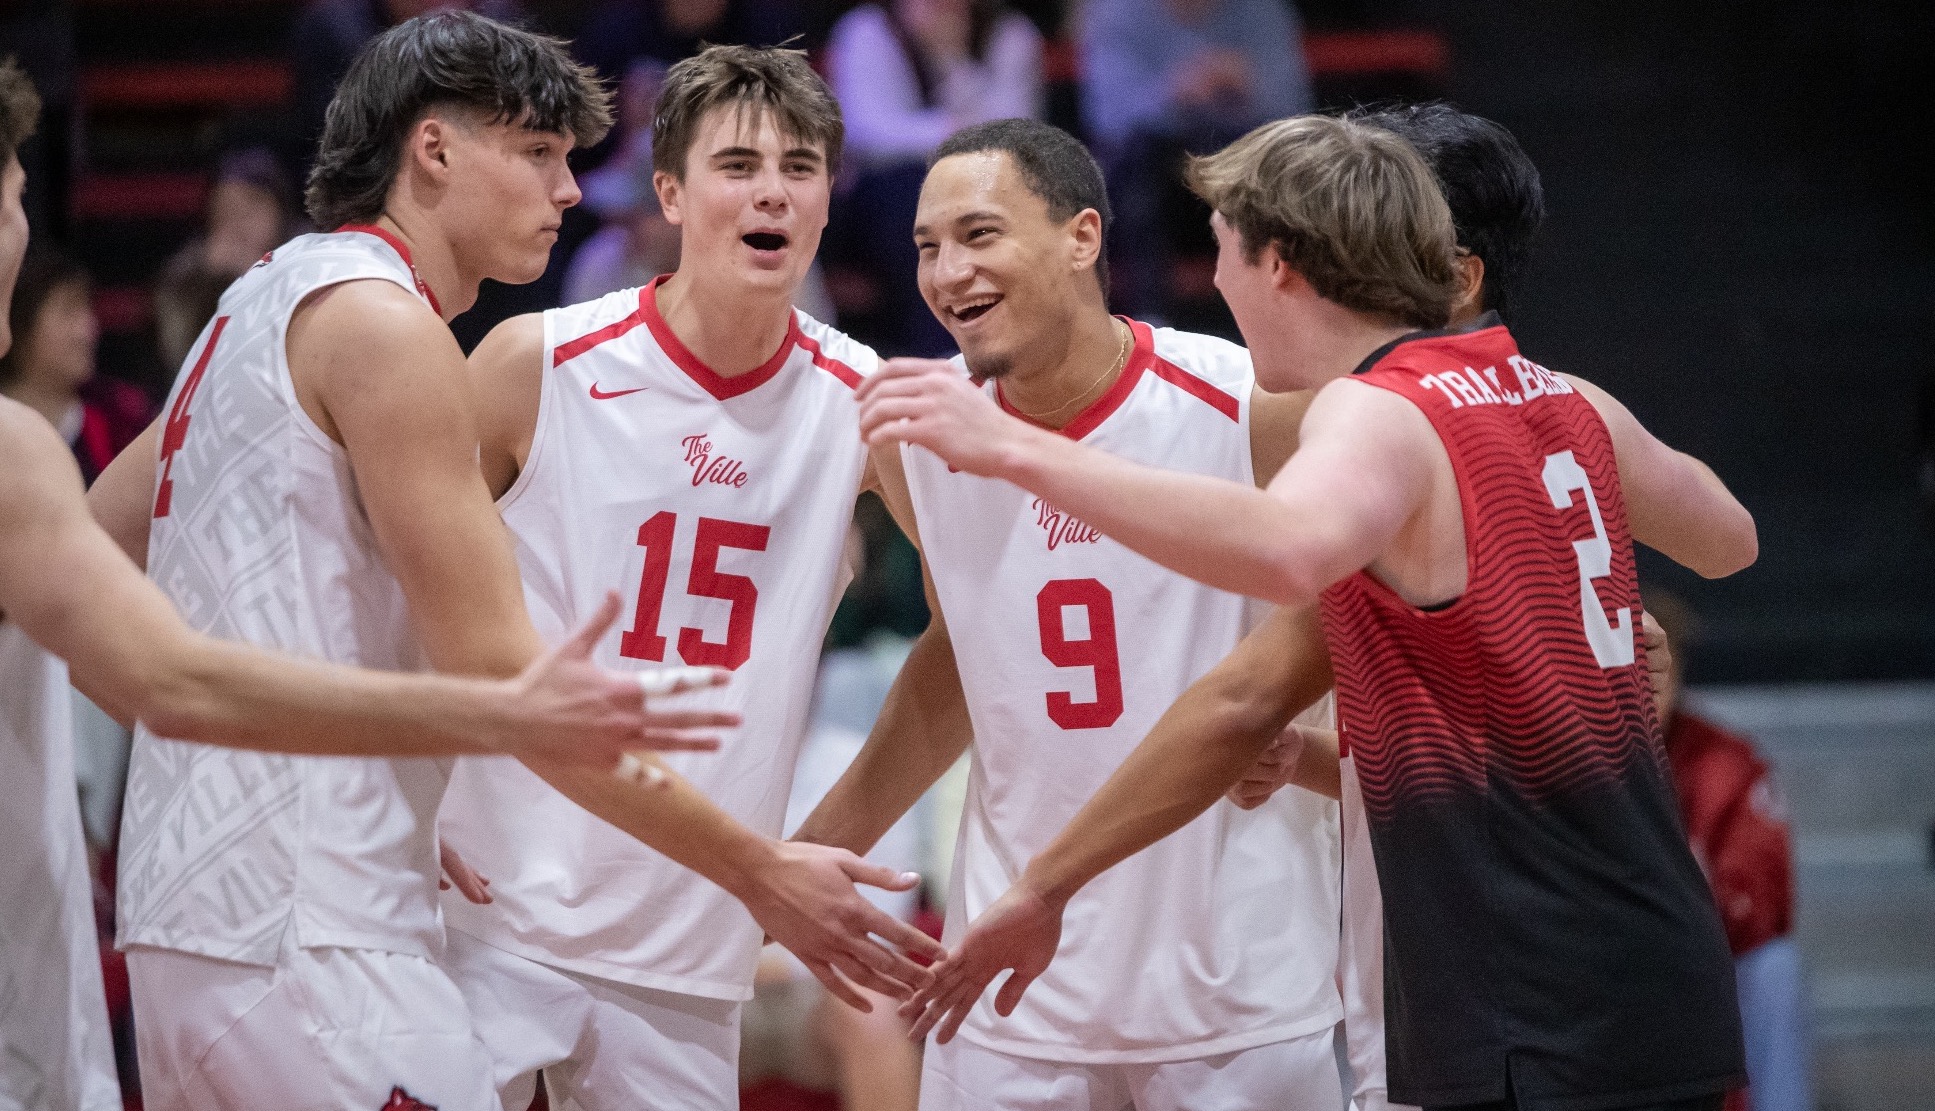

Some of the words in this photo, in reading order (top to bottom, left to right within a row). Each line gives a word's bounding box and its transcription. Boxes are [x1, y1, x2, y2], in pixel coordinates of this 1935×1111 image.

[153, 315, 231, 519] 4
[682, 432, 714, 462] The
[690, 453, 748, 489] Ville
[620, 510, 772, 672] 15
[1043, 512, 1103, 551] Ville
[1542, 450, 1636, 669] 2
[1036, 577, 1125, 731] 9
